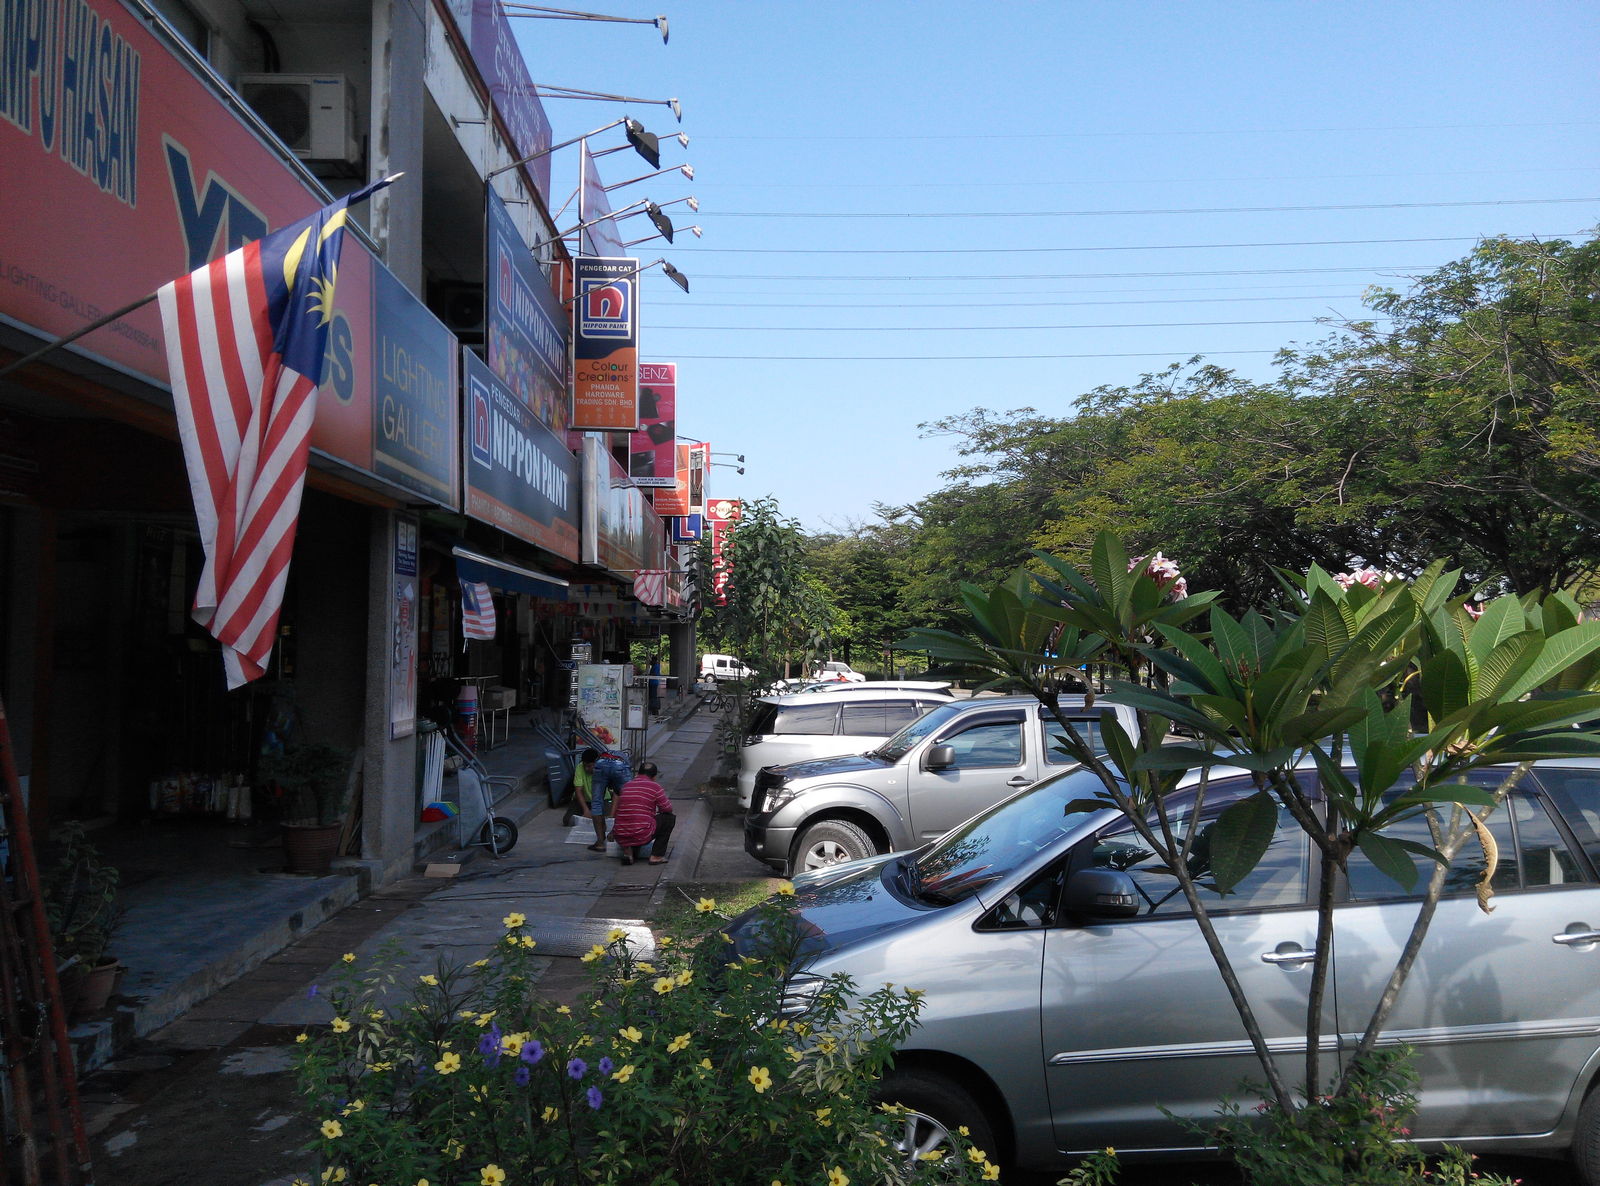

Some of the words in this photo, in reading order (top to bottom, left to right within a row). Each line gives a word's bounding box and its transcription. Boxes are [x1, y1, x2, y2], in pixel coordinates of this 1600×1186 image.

[60, 0, 141, 210] HIASAN
[495, 44, 512, 99] CITY
[514, 281, 545, 346] NIPPON
[544, 331, 564, 374] PAINT
[382, 335, 446, 420] LIGHTING
[577, 371, 629, 382] Creations
[591, 361, 628, 372] Colour
[491, 383, 521, 424] PENGEDAR
[493, 409, 540, 492] NIPPON
[541, 452, 568, 512] PAINT
